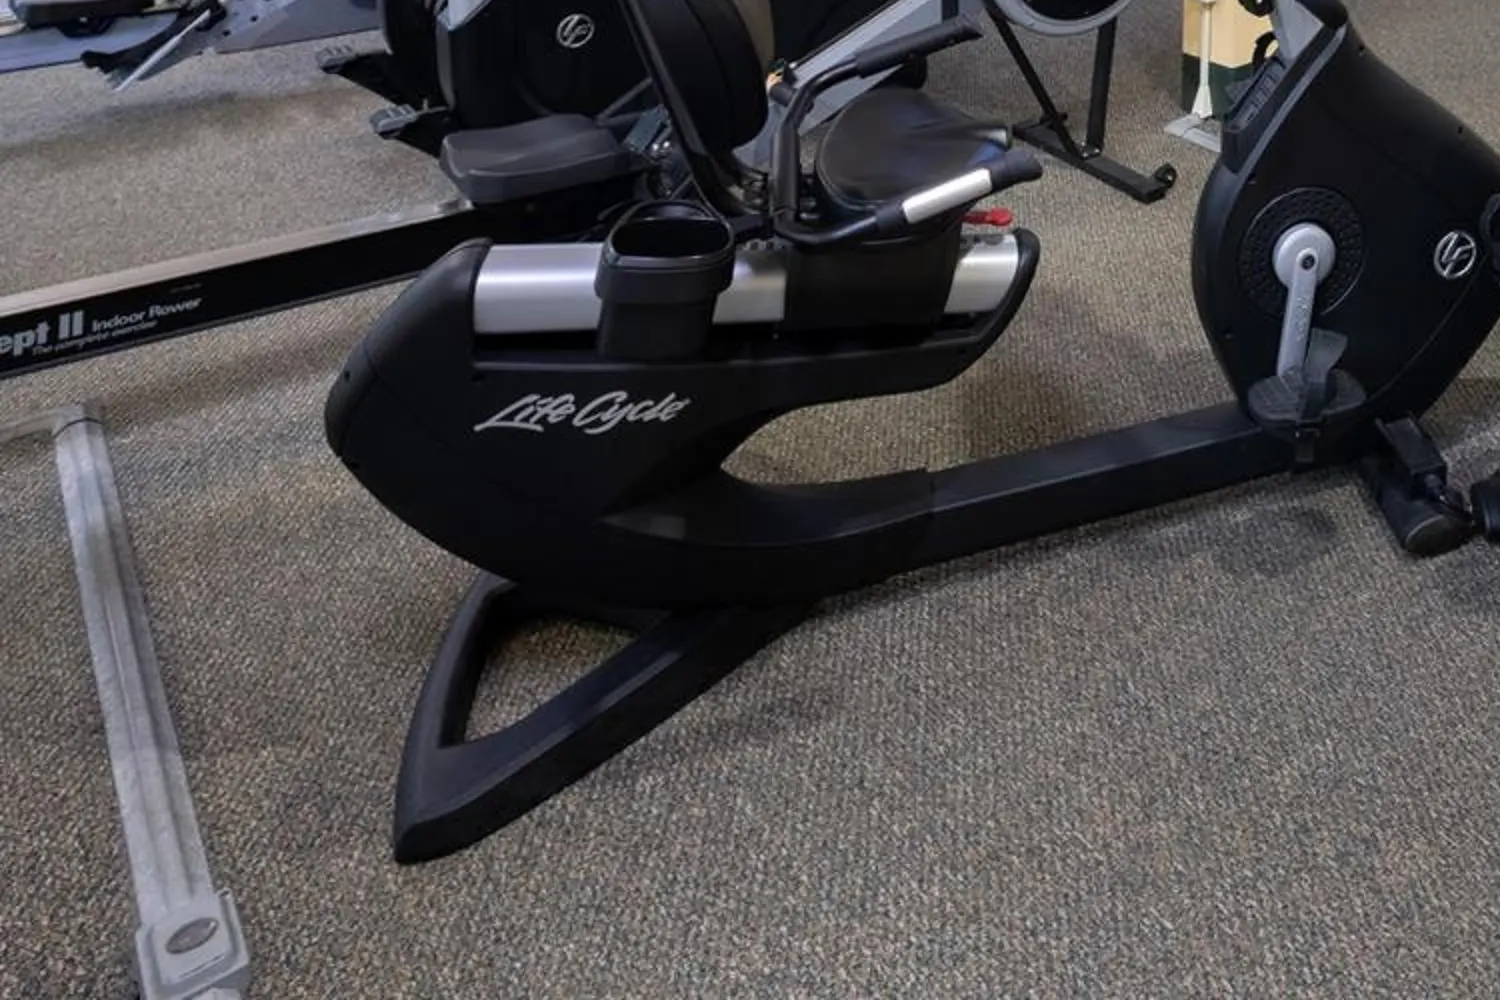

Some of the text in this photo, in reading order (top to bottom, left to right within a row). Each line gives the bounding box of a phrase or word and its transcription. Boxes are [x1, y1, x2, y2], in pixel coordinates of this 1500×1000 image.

[92, 310, 146, 333] Indoor
[150, 298, 203, 319] Rower
[473, 390, 690, 434] Life Cycle
